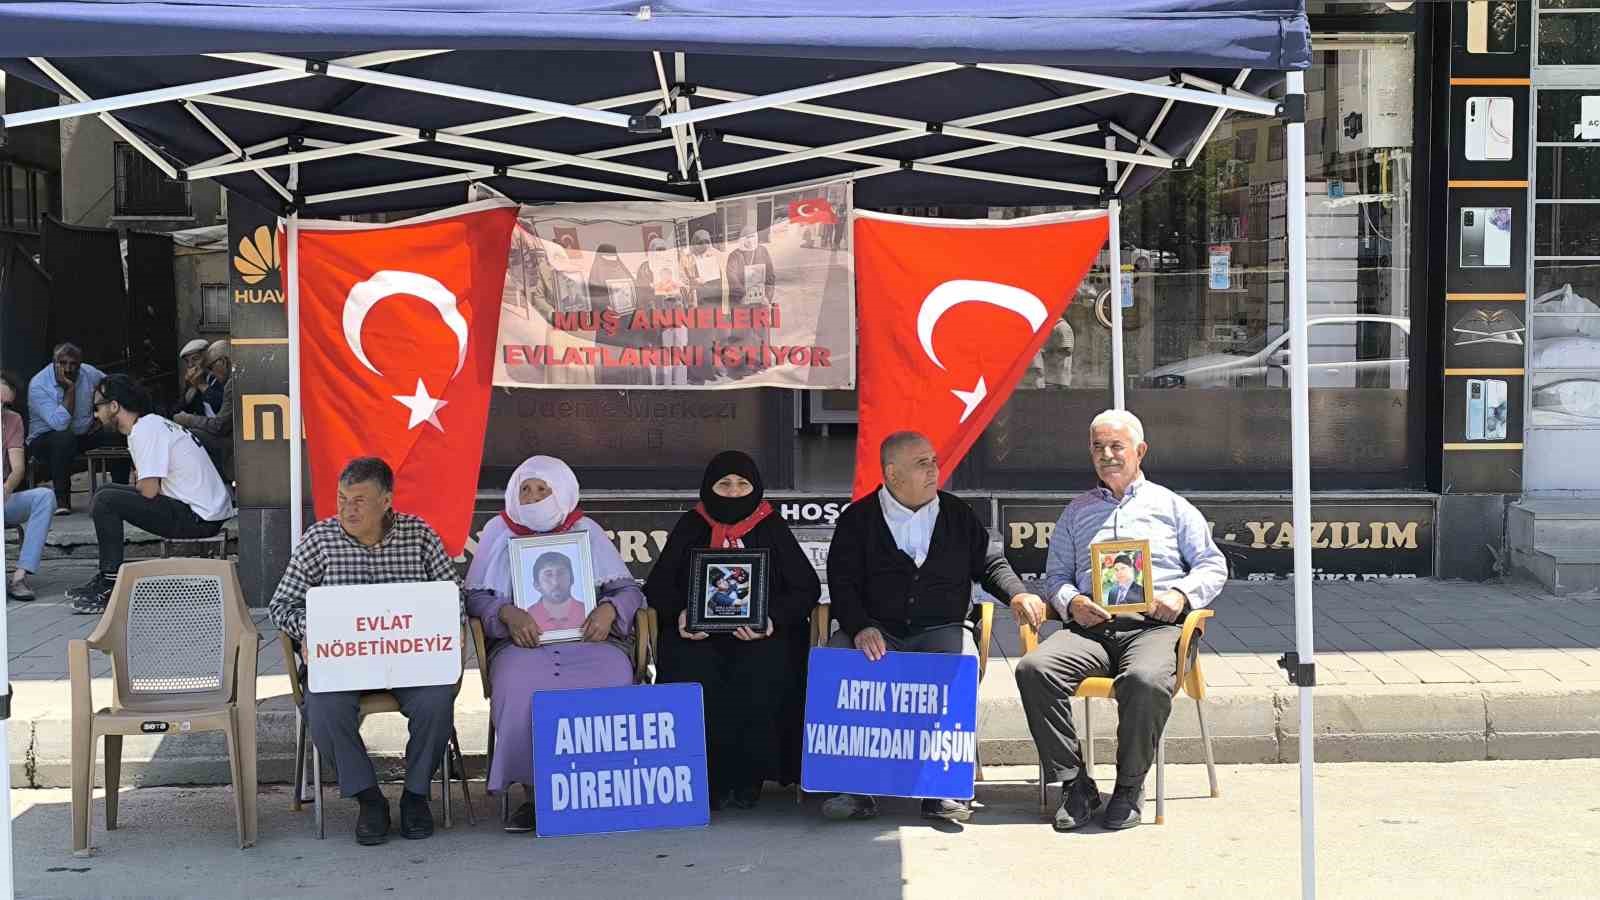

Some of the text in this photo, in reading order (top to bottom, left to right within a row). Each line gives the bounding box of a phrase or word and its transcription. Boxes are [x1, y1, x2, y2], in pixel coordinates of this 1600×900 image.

[552, 303, 782, 336] MUŞ ANNELERİ
[504, 340, 832, 369] EVLATLARINI İSTİYOR
[1246, 521, 1418, 549] YAZILIM
[356, 615, 413, 631] EVLAT
[316, 634, 452, 658] NÖBETİNDEYİZ
[837, 679, 886, 712] ARTIK
[891, 682, 938, 715] YETER
[555, 712, 676, 755] ANNELER
[806, 722, 975, 771] YAKAMIZDAN DÜŞÜN
[552, 757, 693, 811] DİRENİYOR
